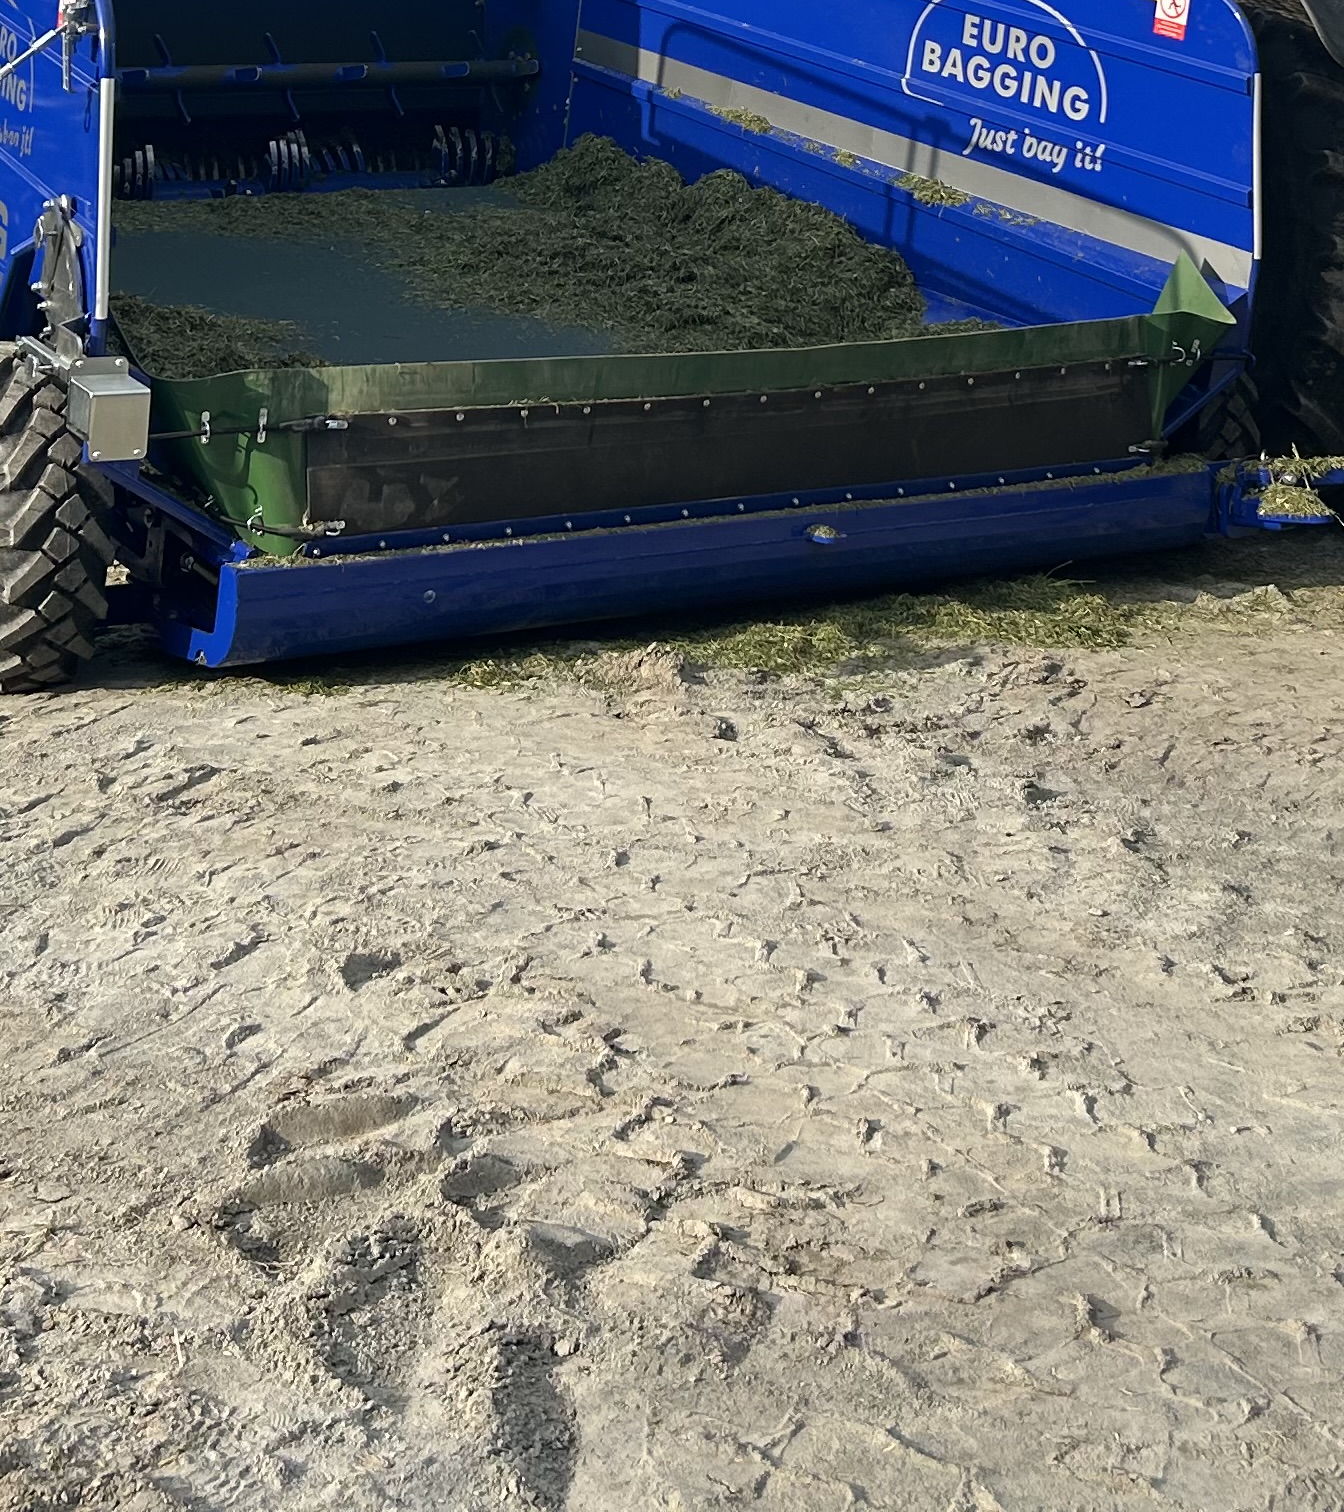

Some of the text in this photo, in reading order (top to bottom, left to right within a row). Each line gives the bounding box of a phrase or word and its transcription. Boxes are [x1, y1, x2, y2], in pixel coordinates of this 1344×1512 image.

[962, 13, 1055, 69] EURO
[922, 39, 1090, 121] BAGGING
[962, 117, 1018, 156] Just
[1074, 141, 1106, 172] it!
